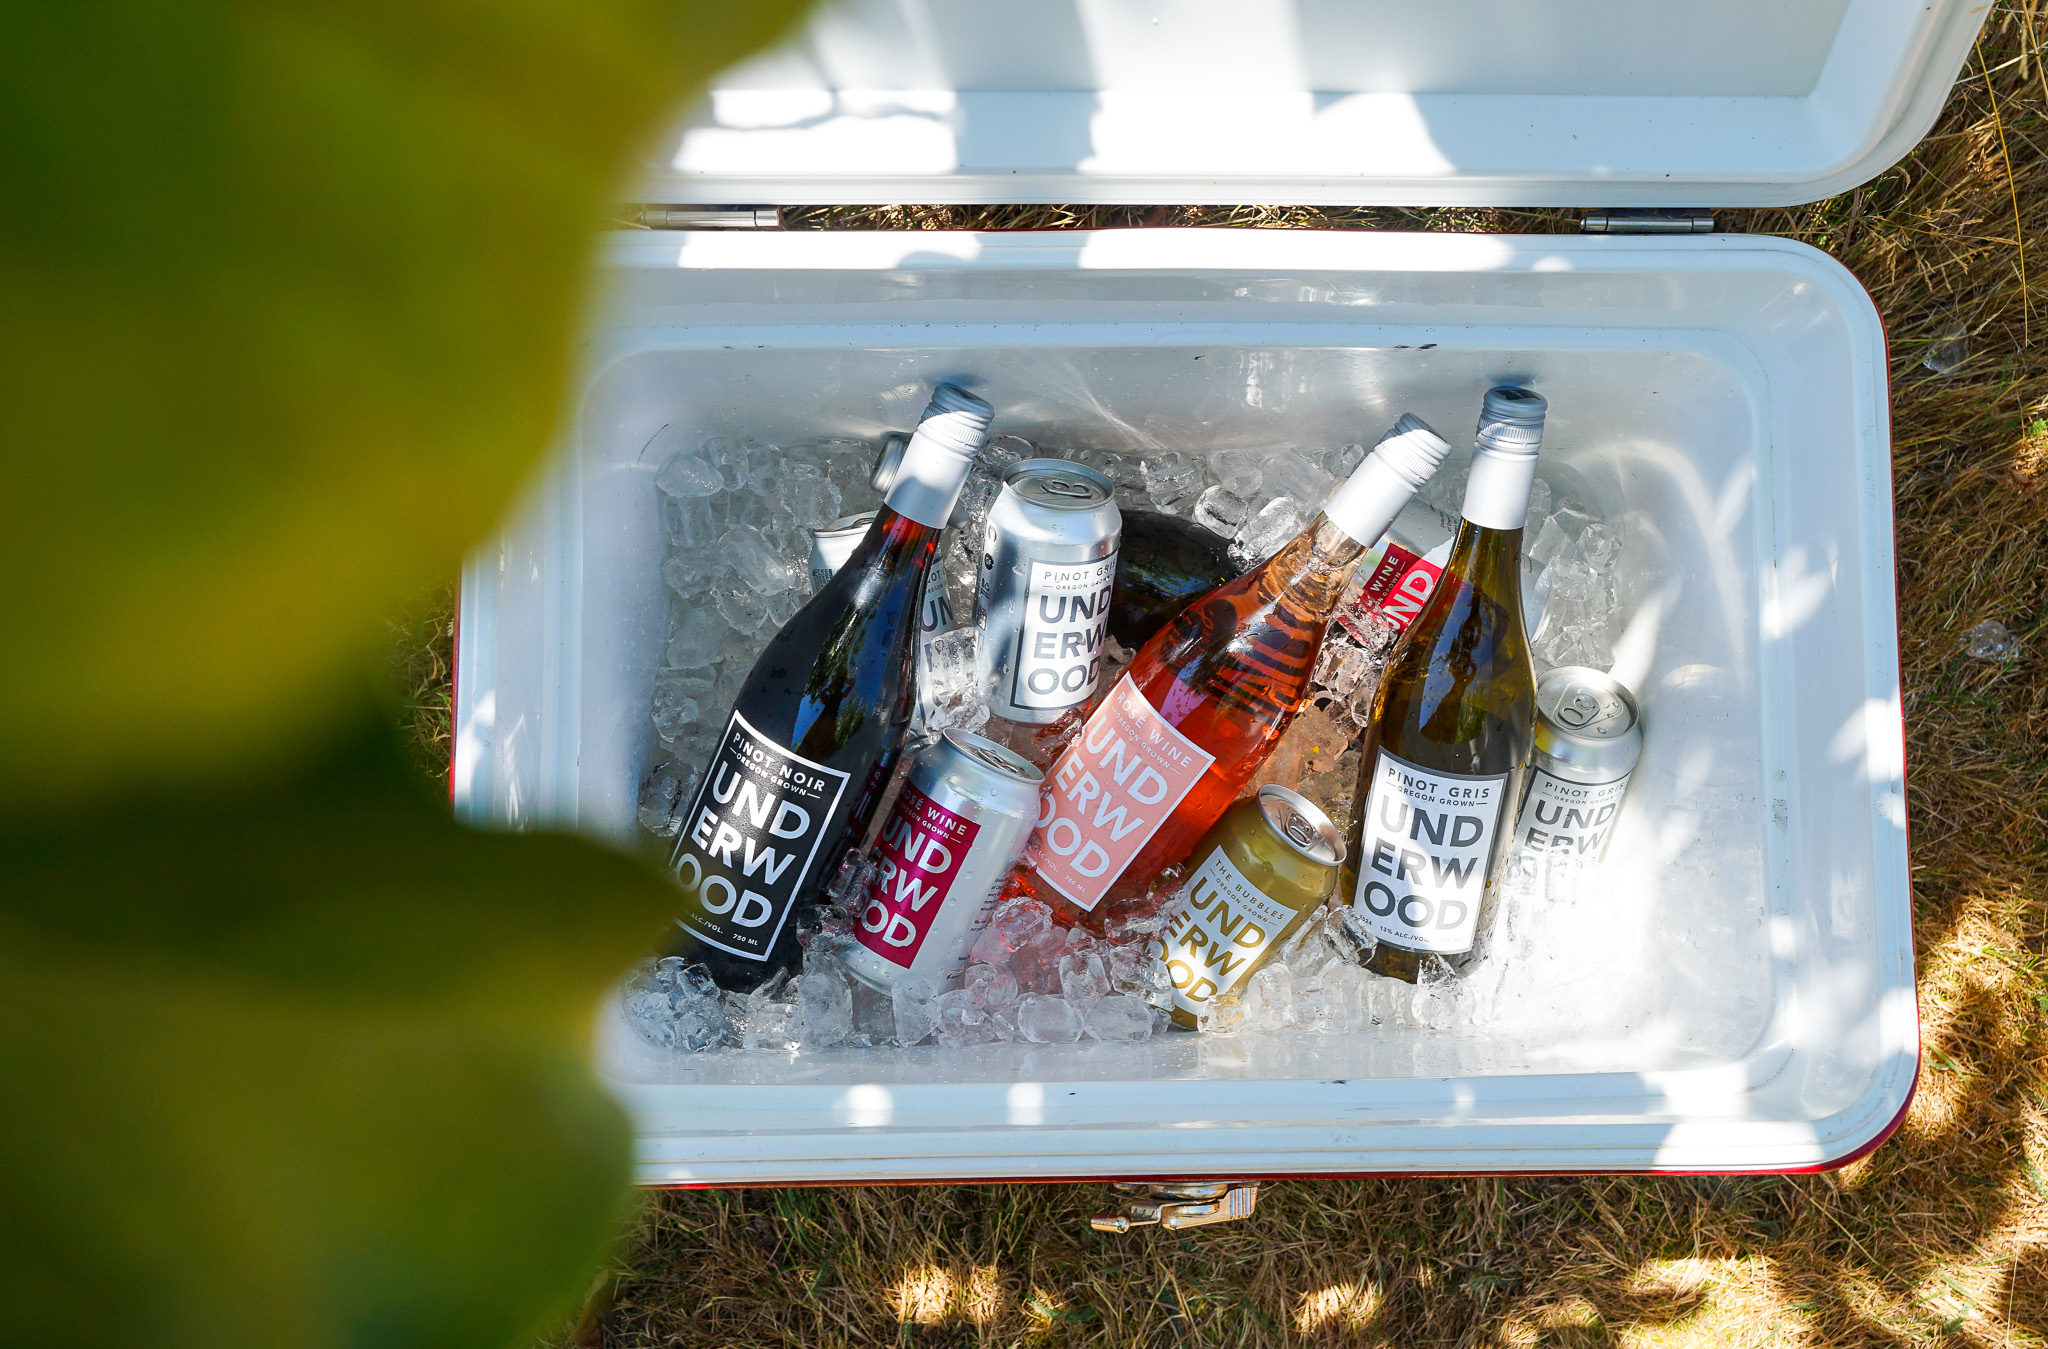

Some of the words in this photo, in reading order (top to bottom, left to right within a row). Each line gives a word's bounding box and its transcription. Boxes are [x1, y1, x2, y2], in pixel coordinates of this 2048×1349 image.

[1044, 571, 1090, 581] PINOT
[1055, 583, 1088, 591] OREGON
[1370, 555, 1399, 592] WINE
[1382, 572, 1402, 596] GROWN
[1039, 585, 1112, 624] UND
[1033, 617, 1108, 660] ERW
[1027, 655, 1101, 695] OOD
[1115, 712, 1140, 742] OREGON
[1141, 741, 1171, 768] GROWN
[1117, 691, 1148, 729] ROSÉ
[1149, 728, 1193, 768] WINE
[733, 732, 776, 768] PINOT
[779, 764, 826, 792] NOIR
[736, 753, 769, 779] OREGON
[770, 775, 808, 796] GROWN
[1086, 714, 1168, 805] UND
[712, 760, 811, 839] UND
[1055, 752, 1145, 842] ERW
[1388, 767, 1439, 793] PINOT
[1449, 786, 1490, 799] GRIS
[1398, 786, 1436, 803] OREGON
[1439, 798, 1475, 807] GROWN
[1545, 781, 1590, 798] PINOT
[1597, 782, 1625, 797] GRIS
[1554, 795, 1587, 805] OREGON
[922, 820, 949, 839] GROWN
[928, 807, 967, 836] WINE
[1380, 795, 1484, 848] UND
[1535, 799, 1616, 829] UND
[691, 805, 797, 886] ERW
[882, 807, 952, 874] UND
[1371, 837, 1478, 889] ERW
[676, 853, 773, 928] OOD
[1215, 859, 1233, 881] THE
[1235, 884, 1285, 921] BUBBLES
[1215, 877, 1242, 904] OREGON
[1242, 904, 1269, 923] GROWN
[1364, 880, 1468, 930] OOD
[1190, 876, 1266, 948] UND
[733, 933, 747, 942] 750
[748, 938, 758, 946] ML
